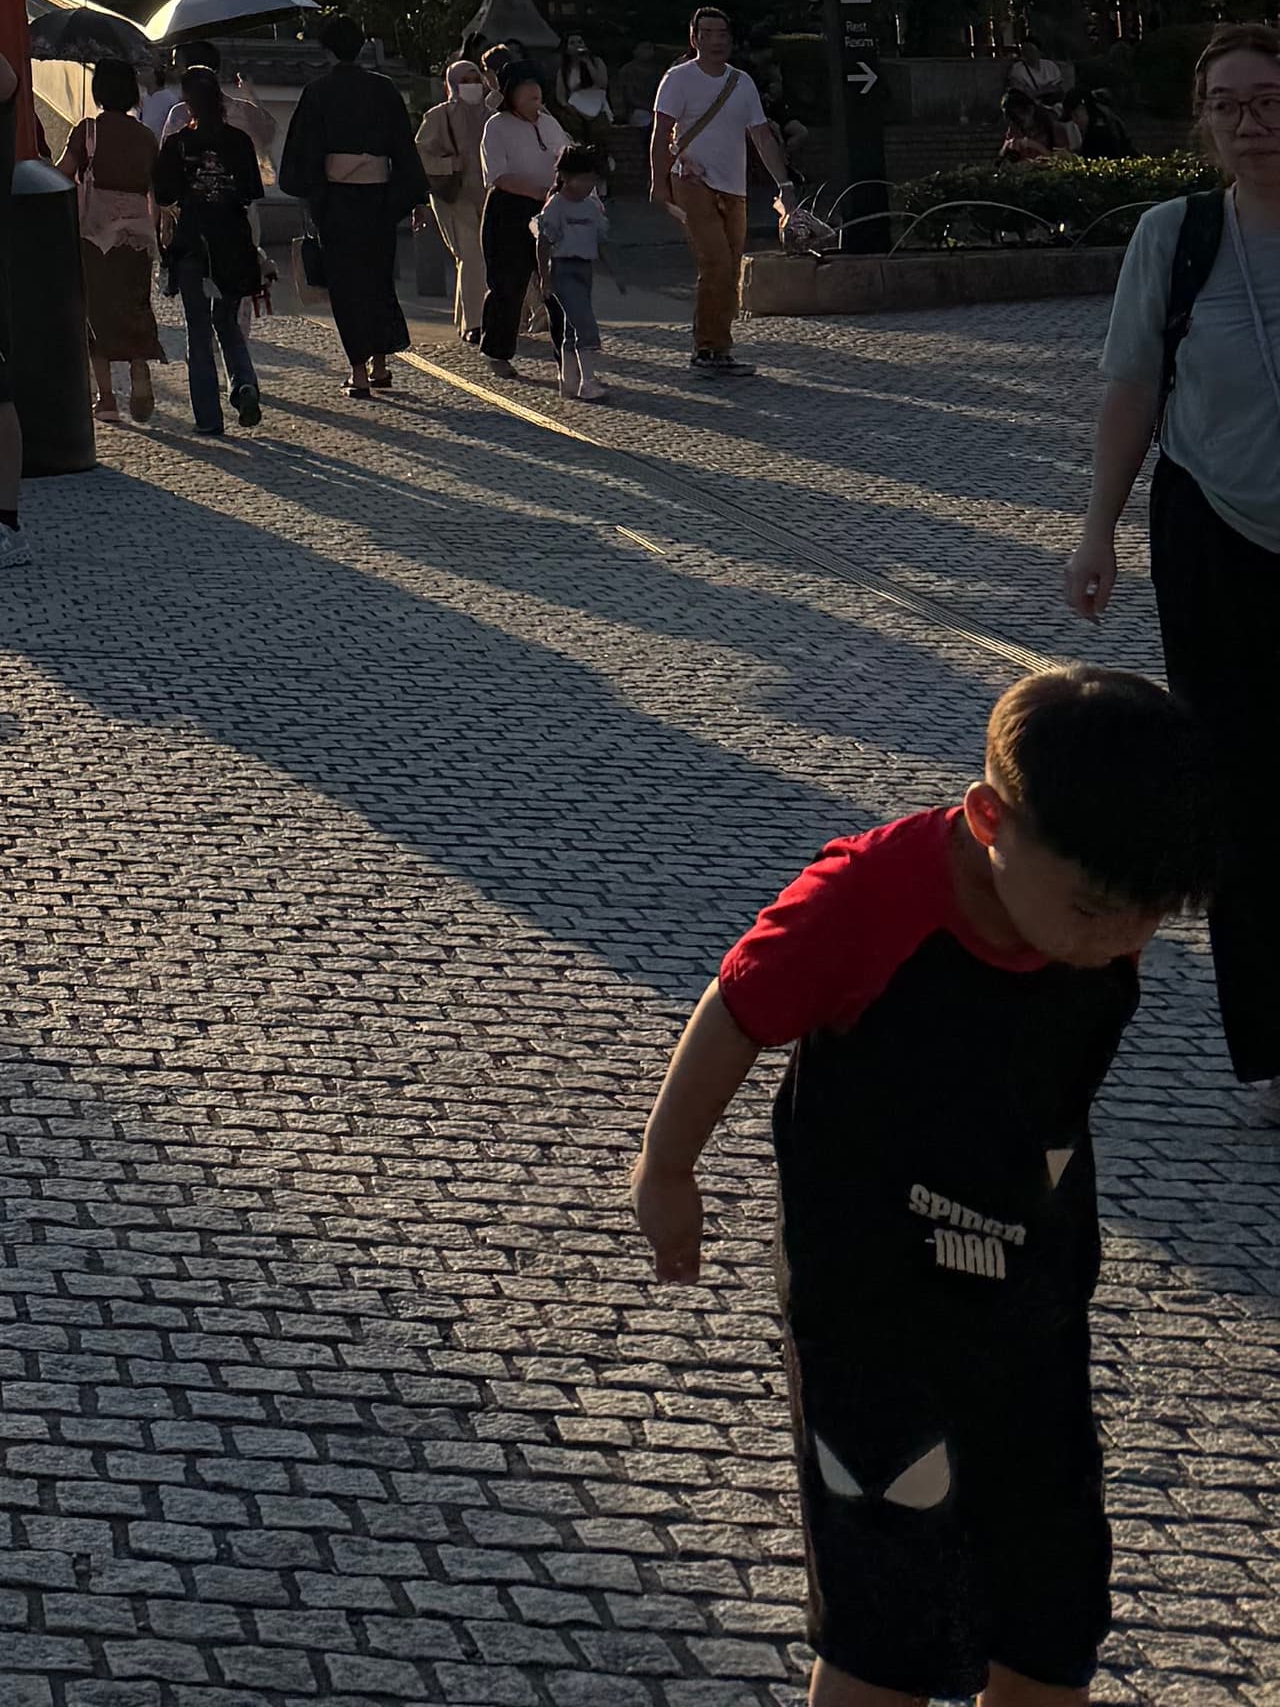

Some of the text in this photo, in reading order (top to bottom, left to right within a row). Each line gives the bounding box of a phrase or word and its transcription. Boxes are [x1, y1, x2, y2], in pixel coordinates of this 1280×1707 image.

[845, 20, 867, 33] Rest
[844, 36, 874, 47] Room
[908, 1183, 1027, 1246] SPIDER
